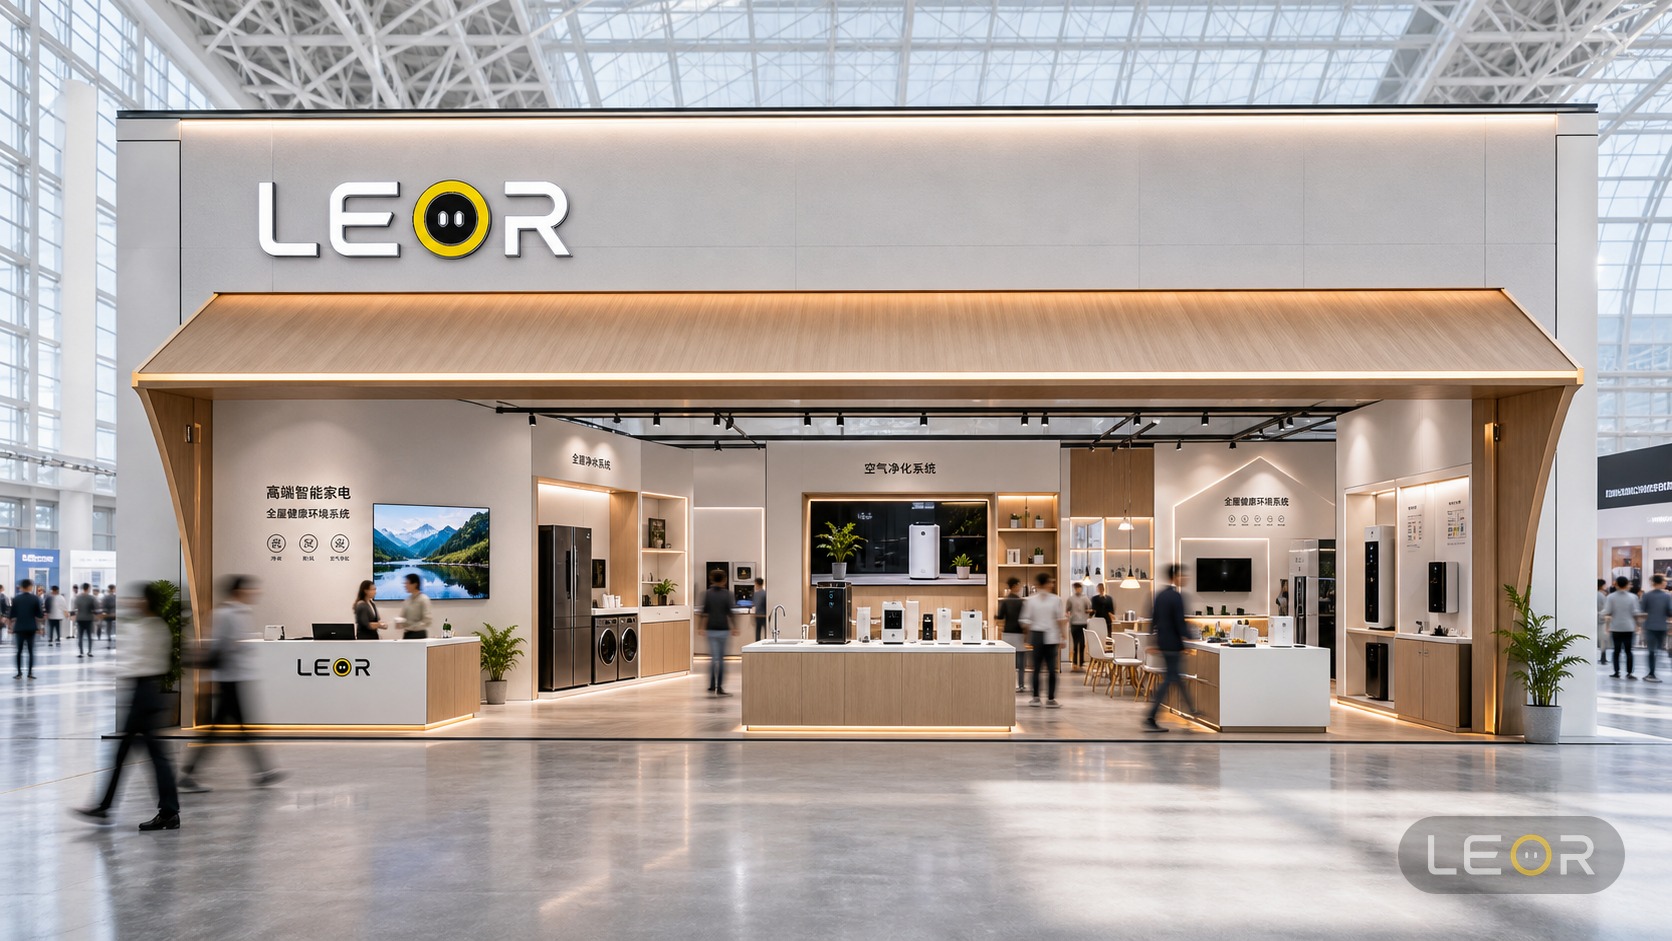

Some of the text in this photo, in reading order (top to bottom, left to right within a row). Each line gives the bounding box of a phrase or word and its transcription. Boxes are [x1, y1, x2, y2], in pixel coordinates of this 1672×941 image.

[257, 179, 574, 259] LEOR
[864, 462, 936, 475] 空气净化系统
[266, 485, 352, 500] 高端智能家电
[297, 657, 371, 678] LEOR
